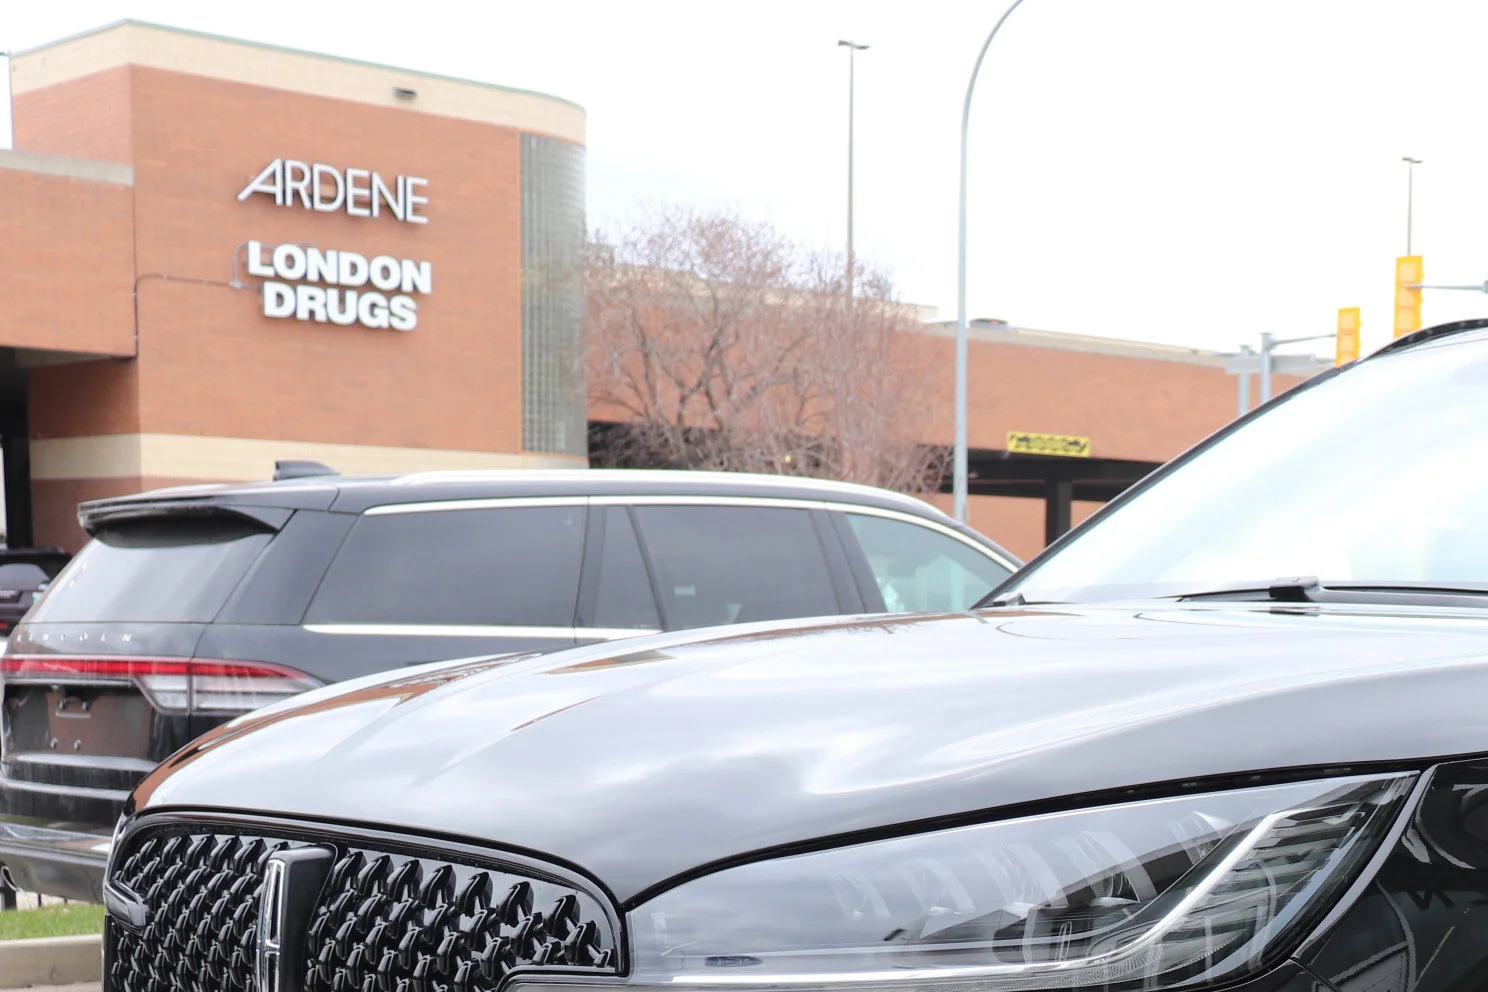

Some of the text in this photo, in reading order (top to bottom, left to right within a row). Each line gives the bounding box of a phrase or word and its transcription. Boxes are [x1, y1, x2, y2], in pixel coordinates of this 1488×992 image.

[236, 157, 429, 225] ARDENE
[248, 239, 432, 295] LONDON
[263, 280, 418, 331] DRUGS
[16, 632, 132, 643] LINCOLN
